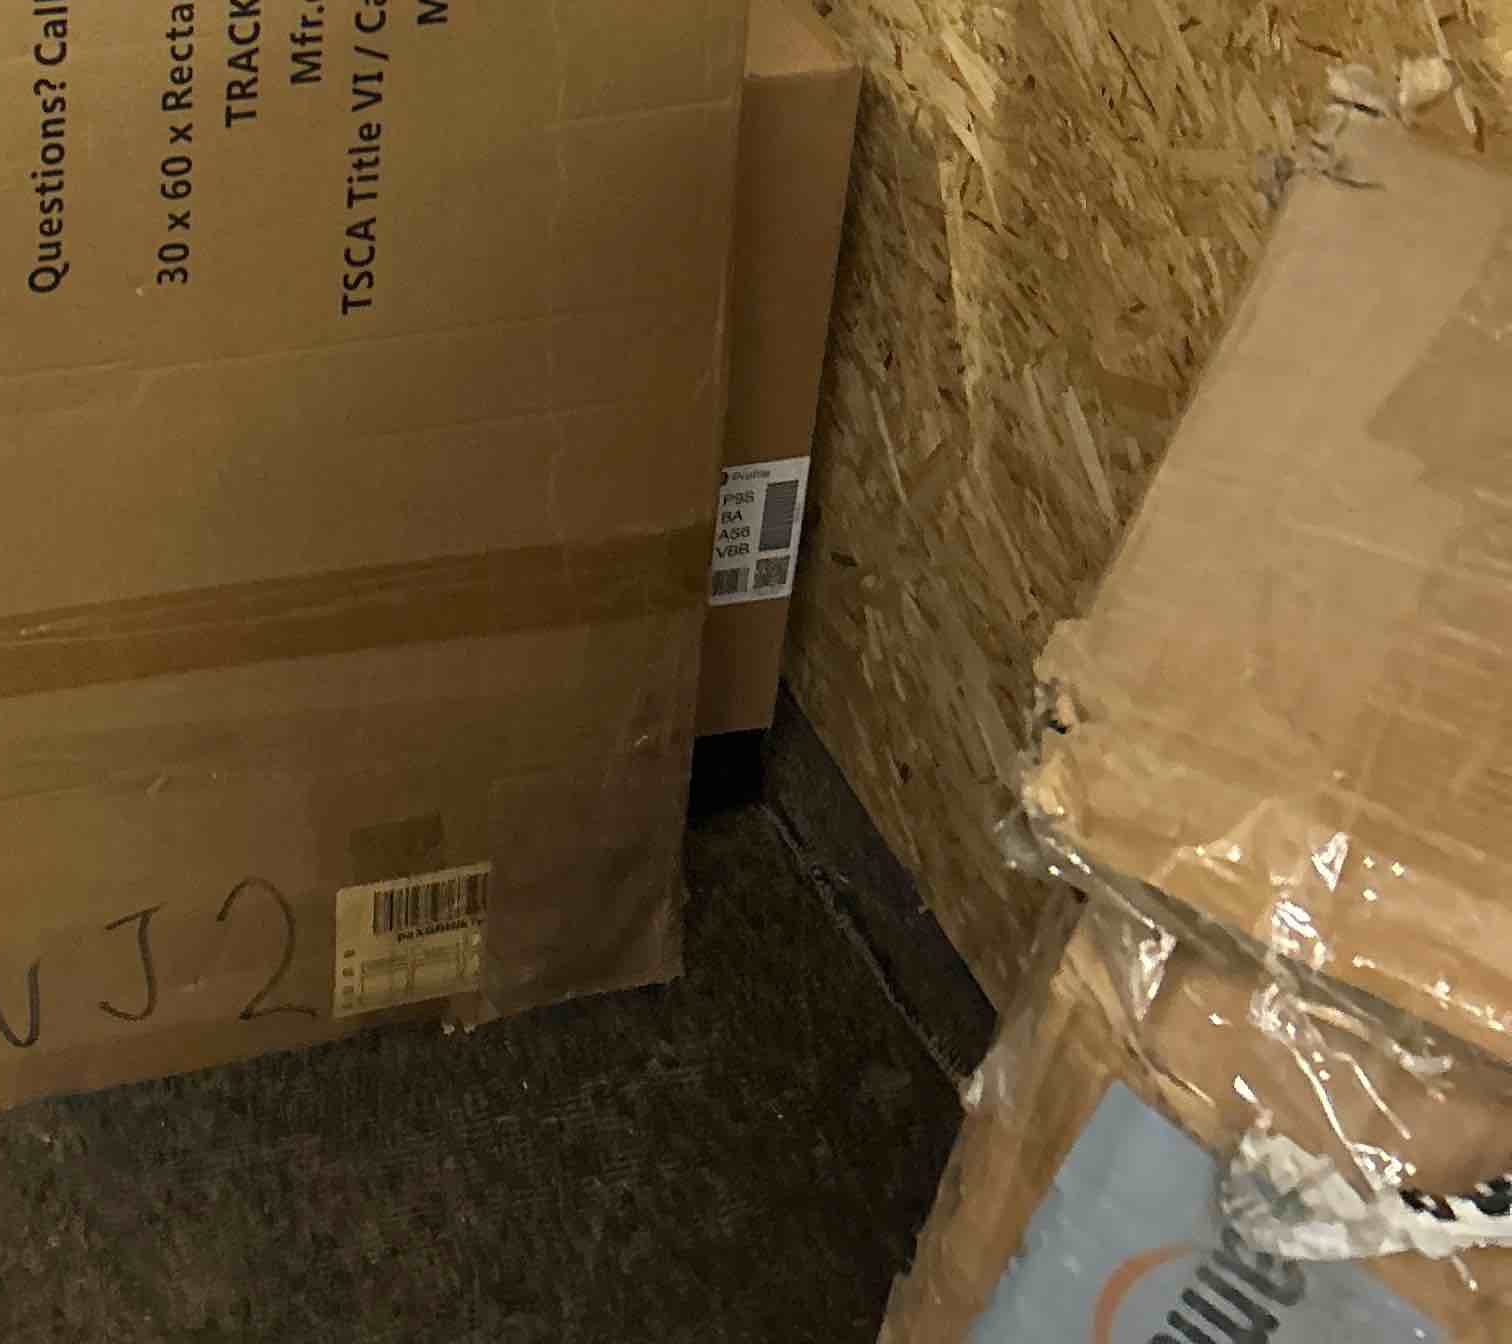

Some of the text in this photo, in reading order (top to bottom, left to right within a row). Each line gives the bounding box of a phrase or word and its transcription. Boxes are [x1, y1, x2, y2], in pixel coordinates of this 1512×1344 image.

[351, 71, 384, 113] VI
[169, 122, 194, 145] x
[27, 78, 71, 294] Questions?
[159, 155, 193, 201] 60
[346, 122, 382, 210] Title
[167, 210, 191, 233] x
[156, 242, 190, 286] 30
[341, 216, 377, 316] TSCA
